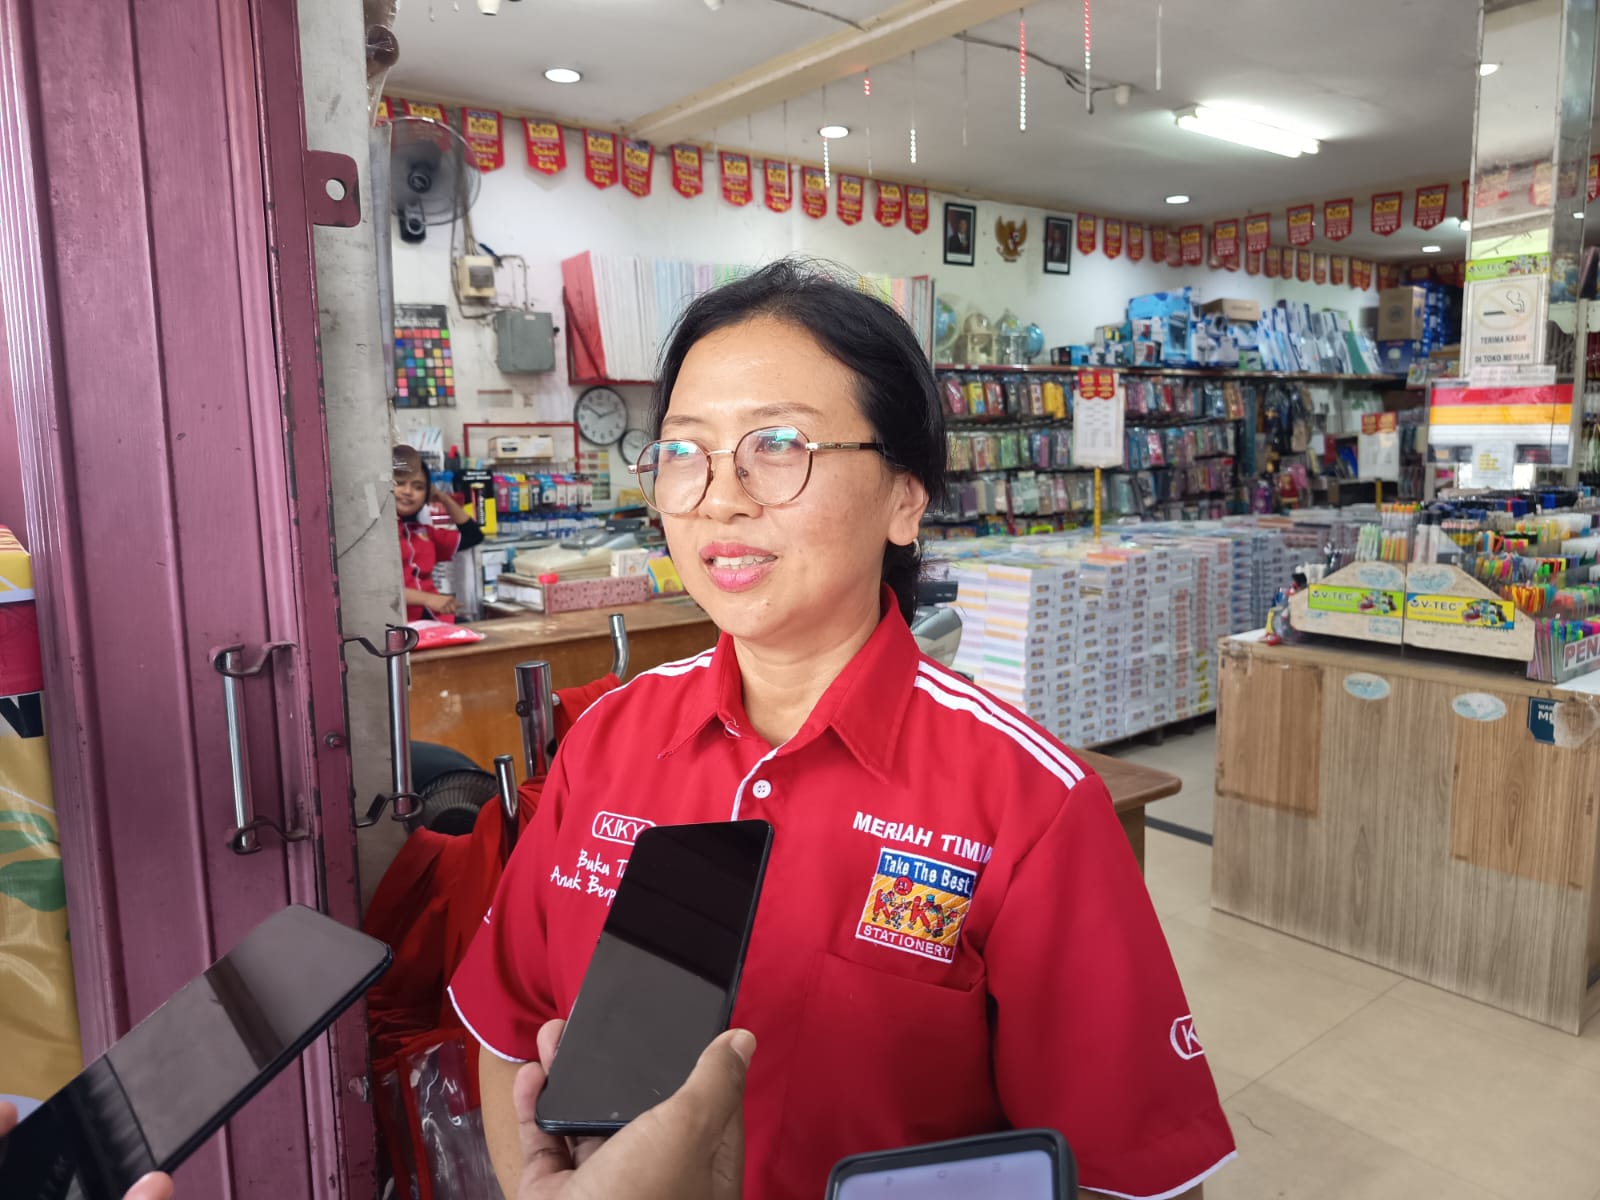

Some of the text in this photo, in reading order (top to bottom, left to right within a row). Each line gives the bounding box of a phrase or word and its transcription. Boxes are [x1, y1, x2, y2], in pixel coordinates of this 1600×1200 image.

[598, 816, 646, 841] KIKY
[852, 810, 934, 848] MERIAH
[550, 865, 582, 892] Anak
[576, 848, 629, 879] Buka T
[884, 855, 971, 895] Take The Best
[863, 925, 952, 958] STATIONERY
